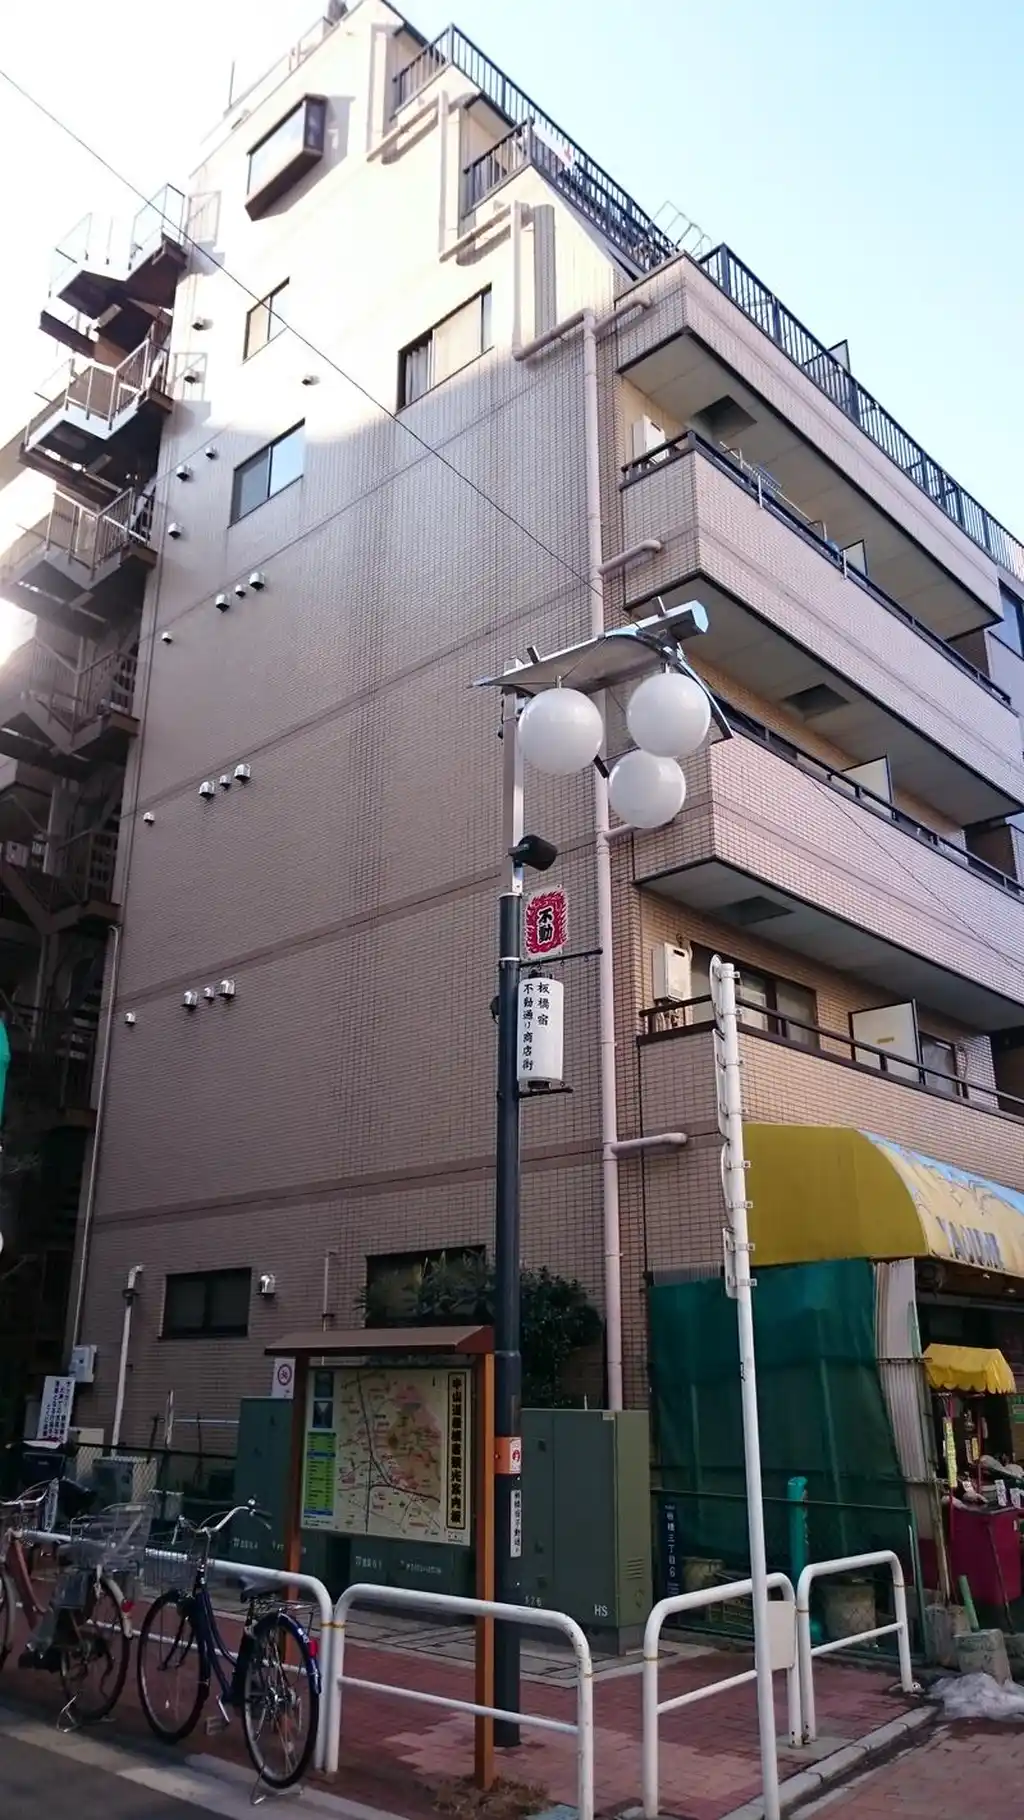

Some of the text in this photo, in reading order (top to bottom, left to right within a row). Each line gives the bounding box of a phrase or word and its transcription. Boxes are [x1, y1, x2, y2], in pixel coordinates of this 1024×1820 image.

[538, 907, 554, 944] 不動
[537, 981, 550, 1026] 板橋宿
[521, 983, 534, 1071] 不動通り商店街
[594, 1604, 608, 1616] HS
